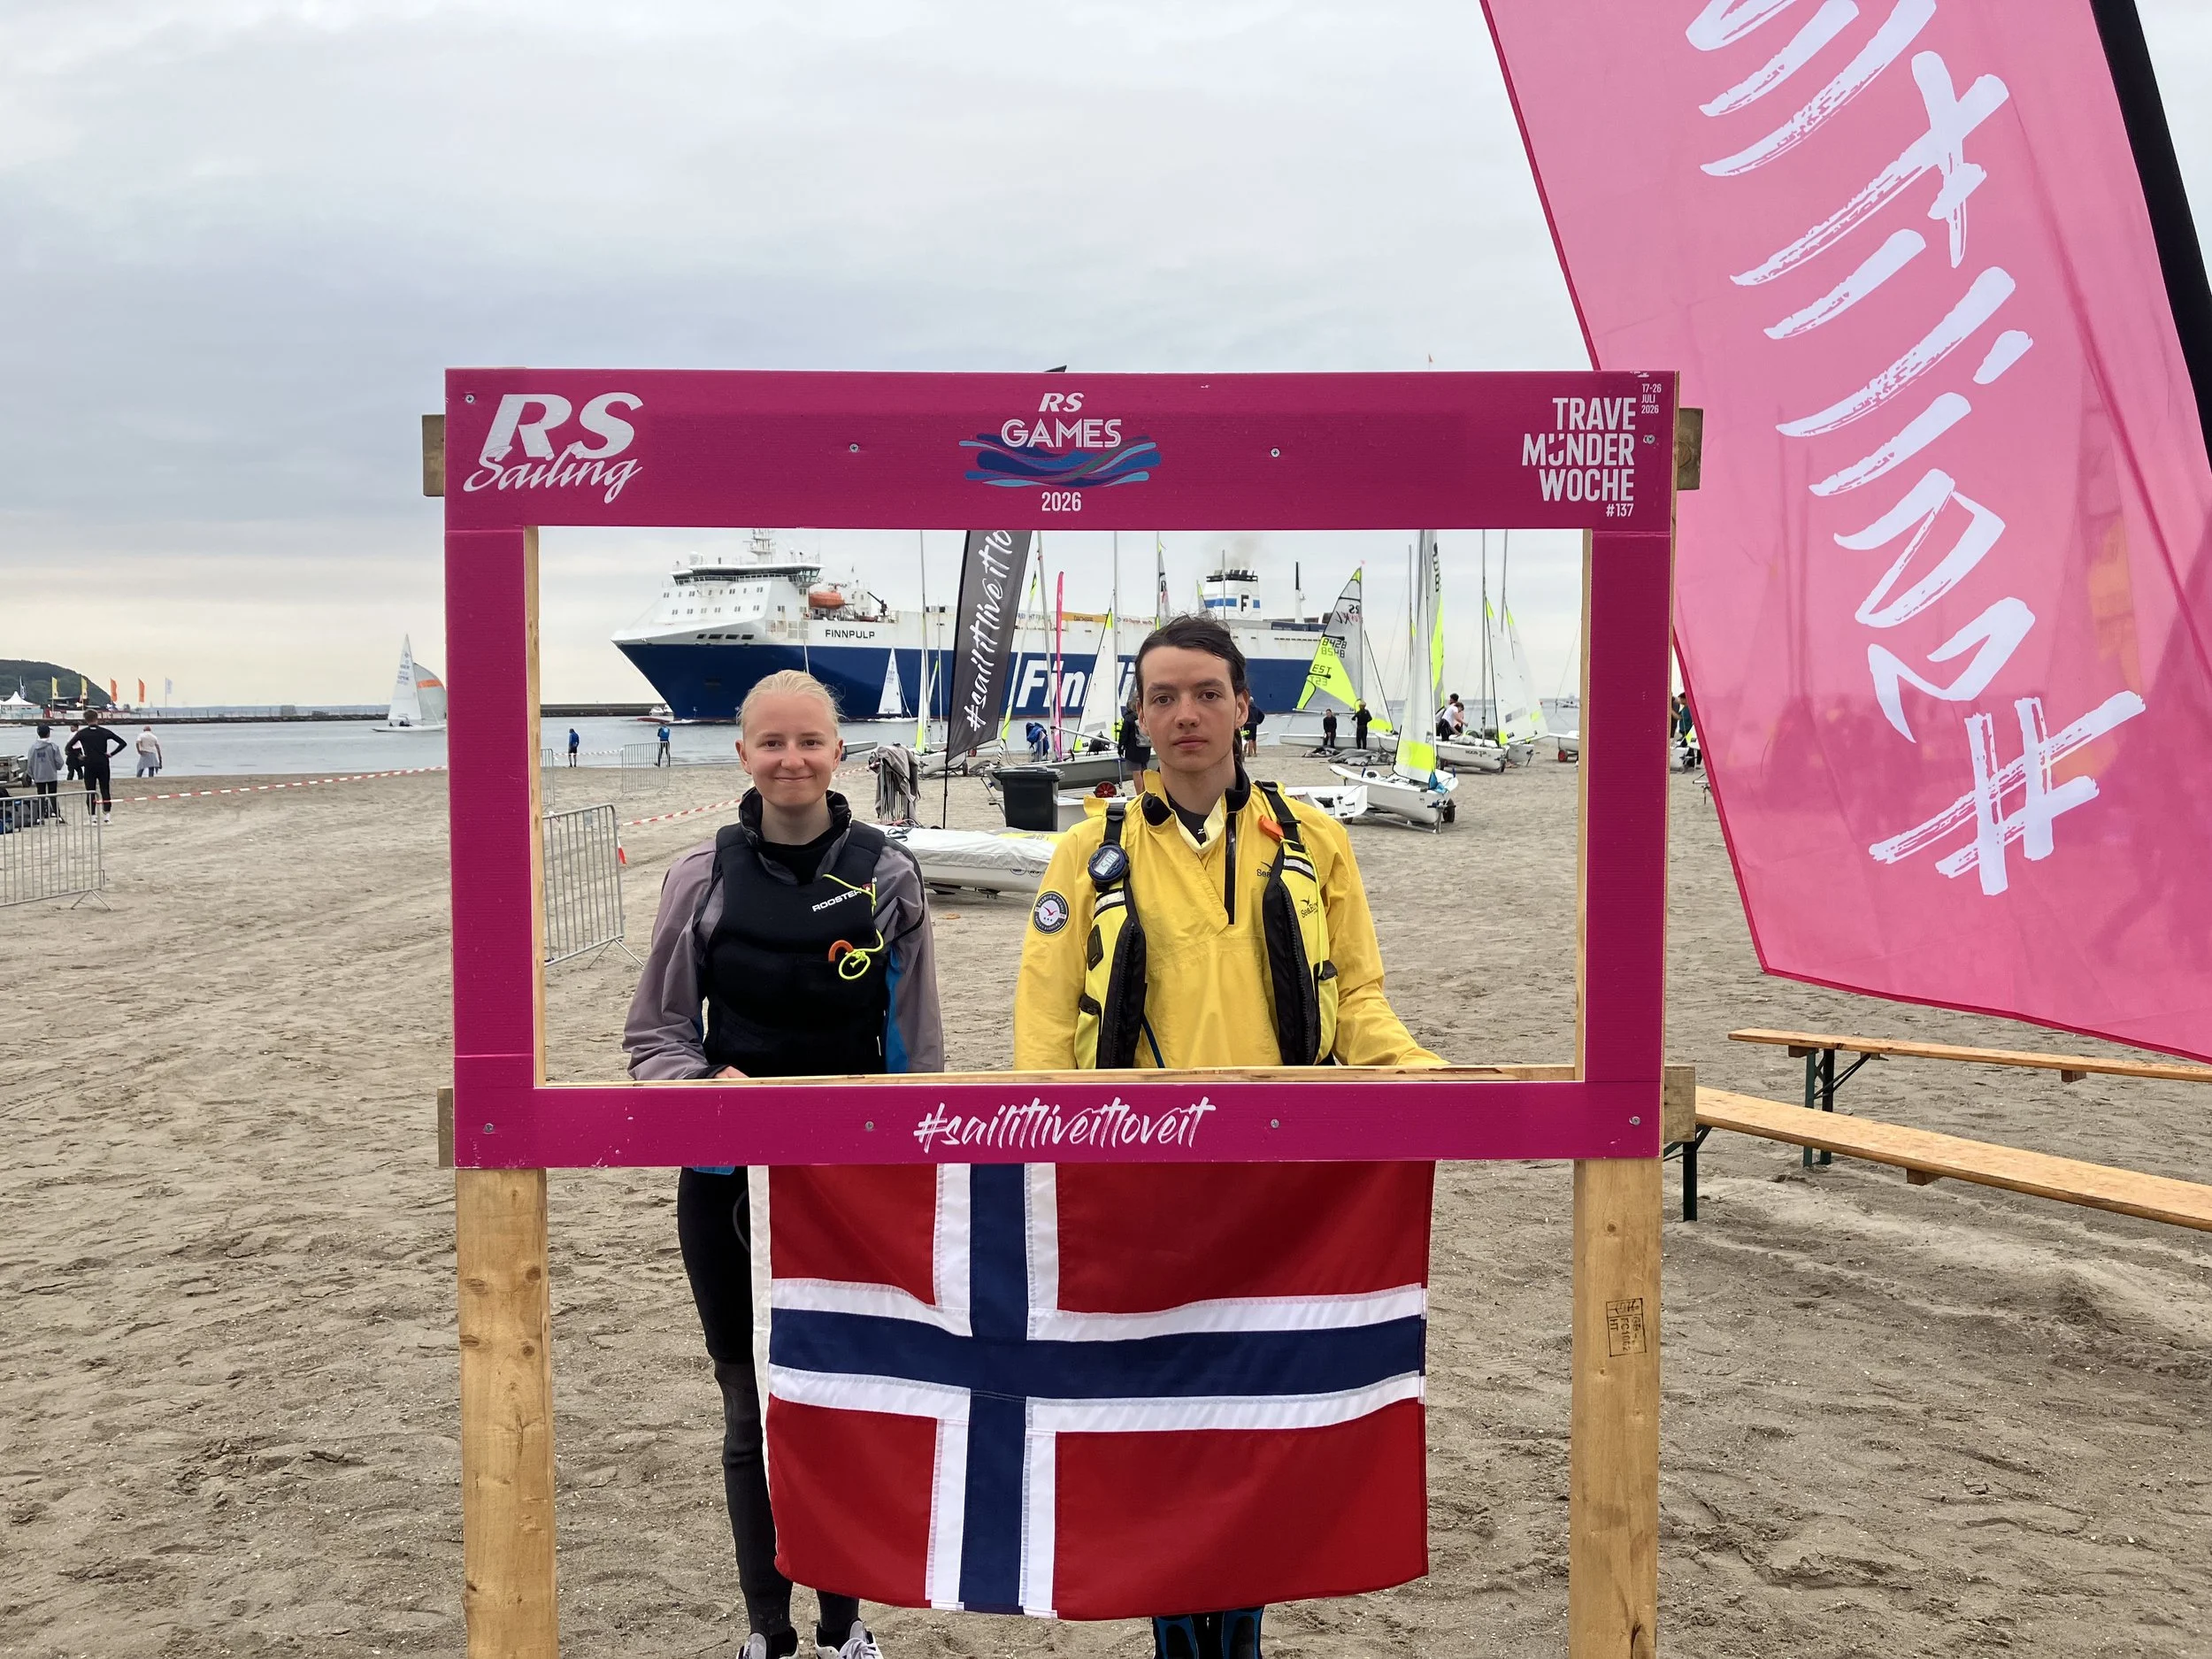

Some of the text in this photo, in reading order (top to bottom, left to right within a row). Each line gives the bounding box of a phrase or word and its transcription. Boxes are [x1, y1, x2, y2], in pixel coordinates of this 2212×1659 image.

[1641, 383, 1662, 393] 17-26
[1038, 392, 1085, 412] RS
[1640, 394, 1655, 403] JULI
[1552, 397, 1636, 431] TRAVE
[1640, 404, 1659, 414] 2026
[480, 391, 644, 459] RS
[1001, 418, 1122, 448] GAMES
[463, 444, 643, 504] Sailing
[1539, 468, 1634, 502] WOCHE
[1041, 491, 1082, 512] 2026
[1605, 503, 1634, 517] #137
[1240, 594, 1249, 612] F
[825, 629, 875, 640] FINNPULP
[1321, 637, 1348, 650] 8428
[811, 889, 863, 912] ROOSTER
[1609, 1318, 1619, 1332] HT
